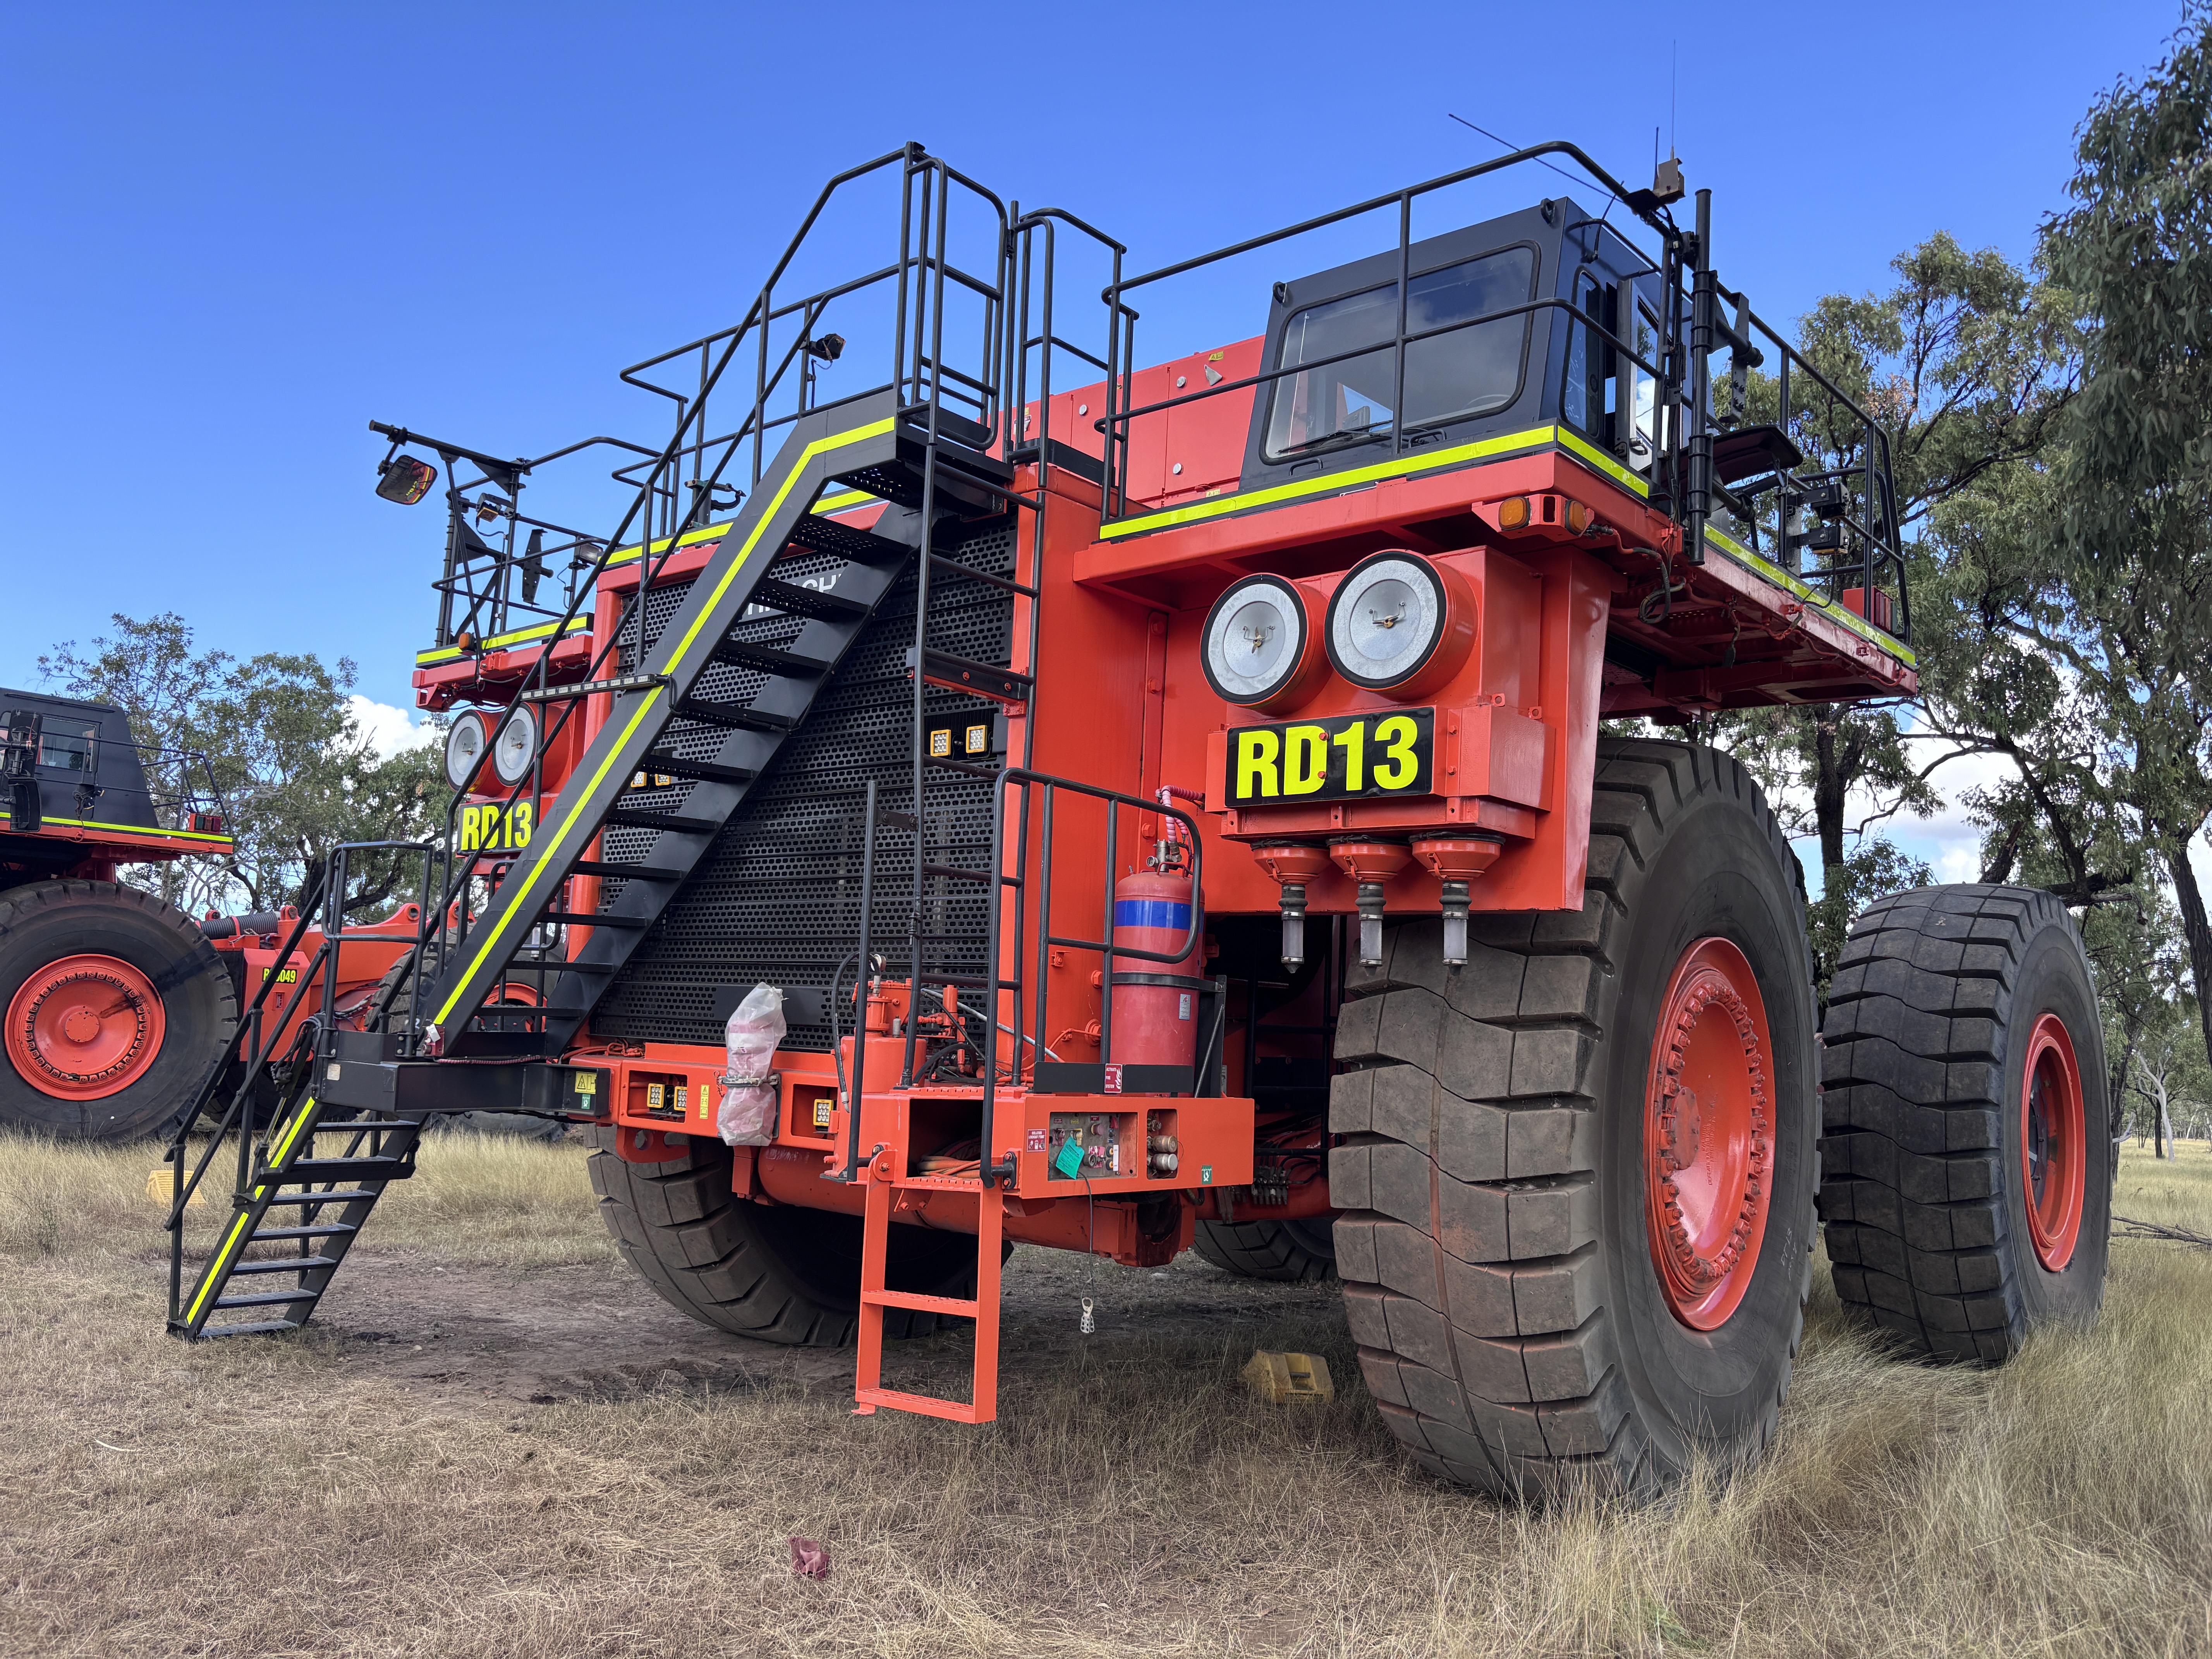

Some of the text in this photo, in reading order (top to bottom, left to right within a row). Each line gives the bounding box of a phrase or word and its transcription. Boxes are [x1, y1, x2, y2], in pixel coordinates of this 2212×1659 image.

[1237, 715, 1419, 799] RD13
[461, 802, 532, 850] RD13
[263, 968, 296, 983] R049
